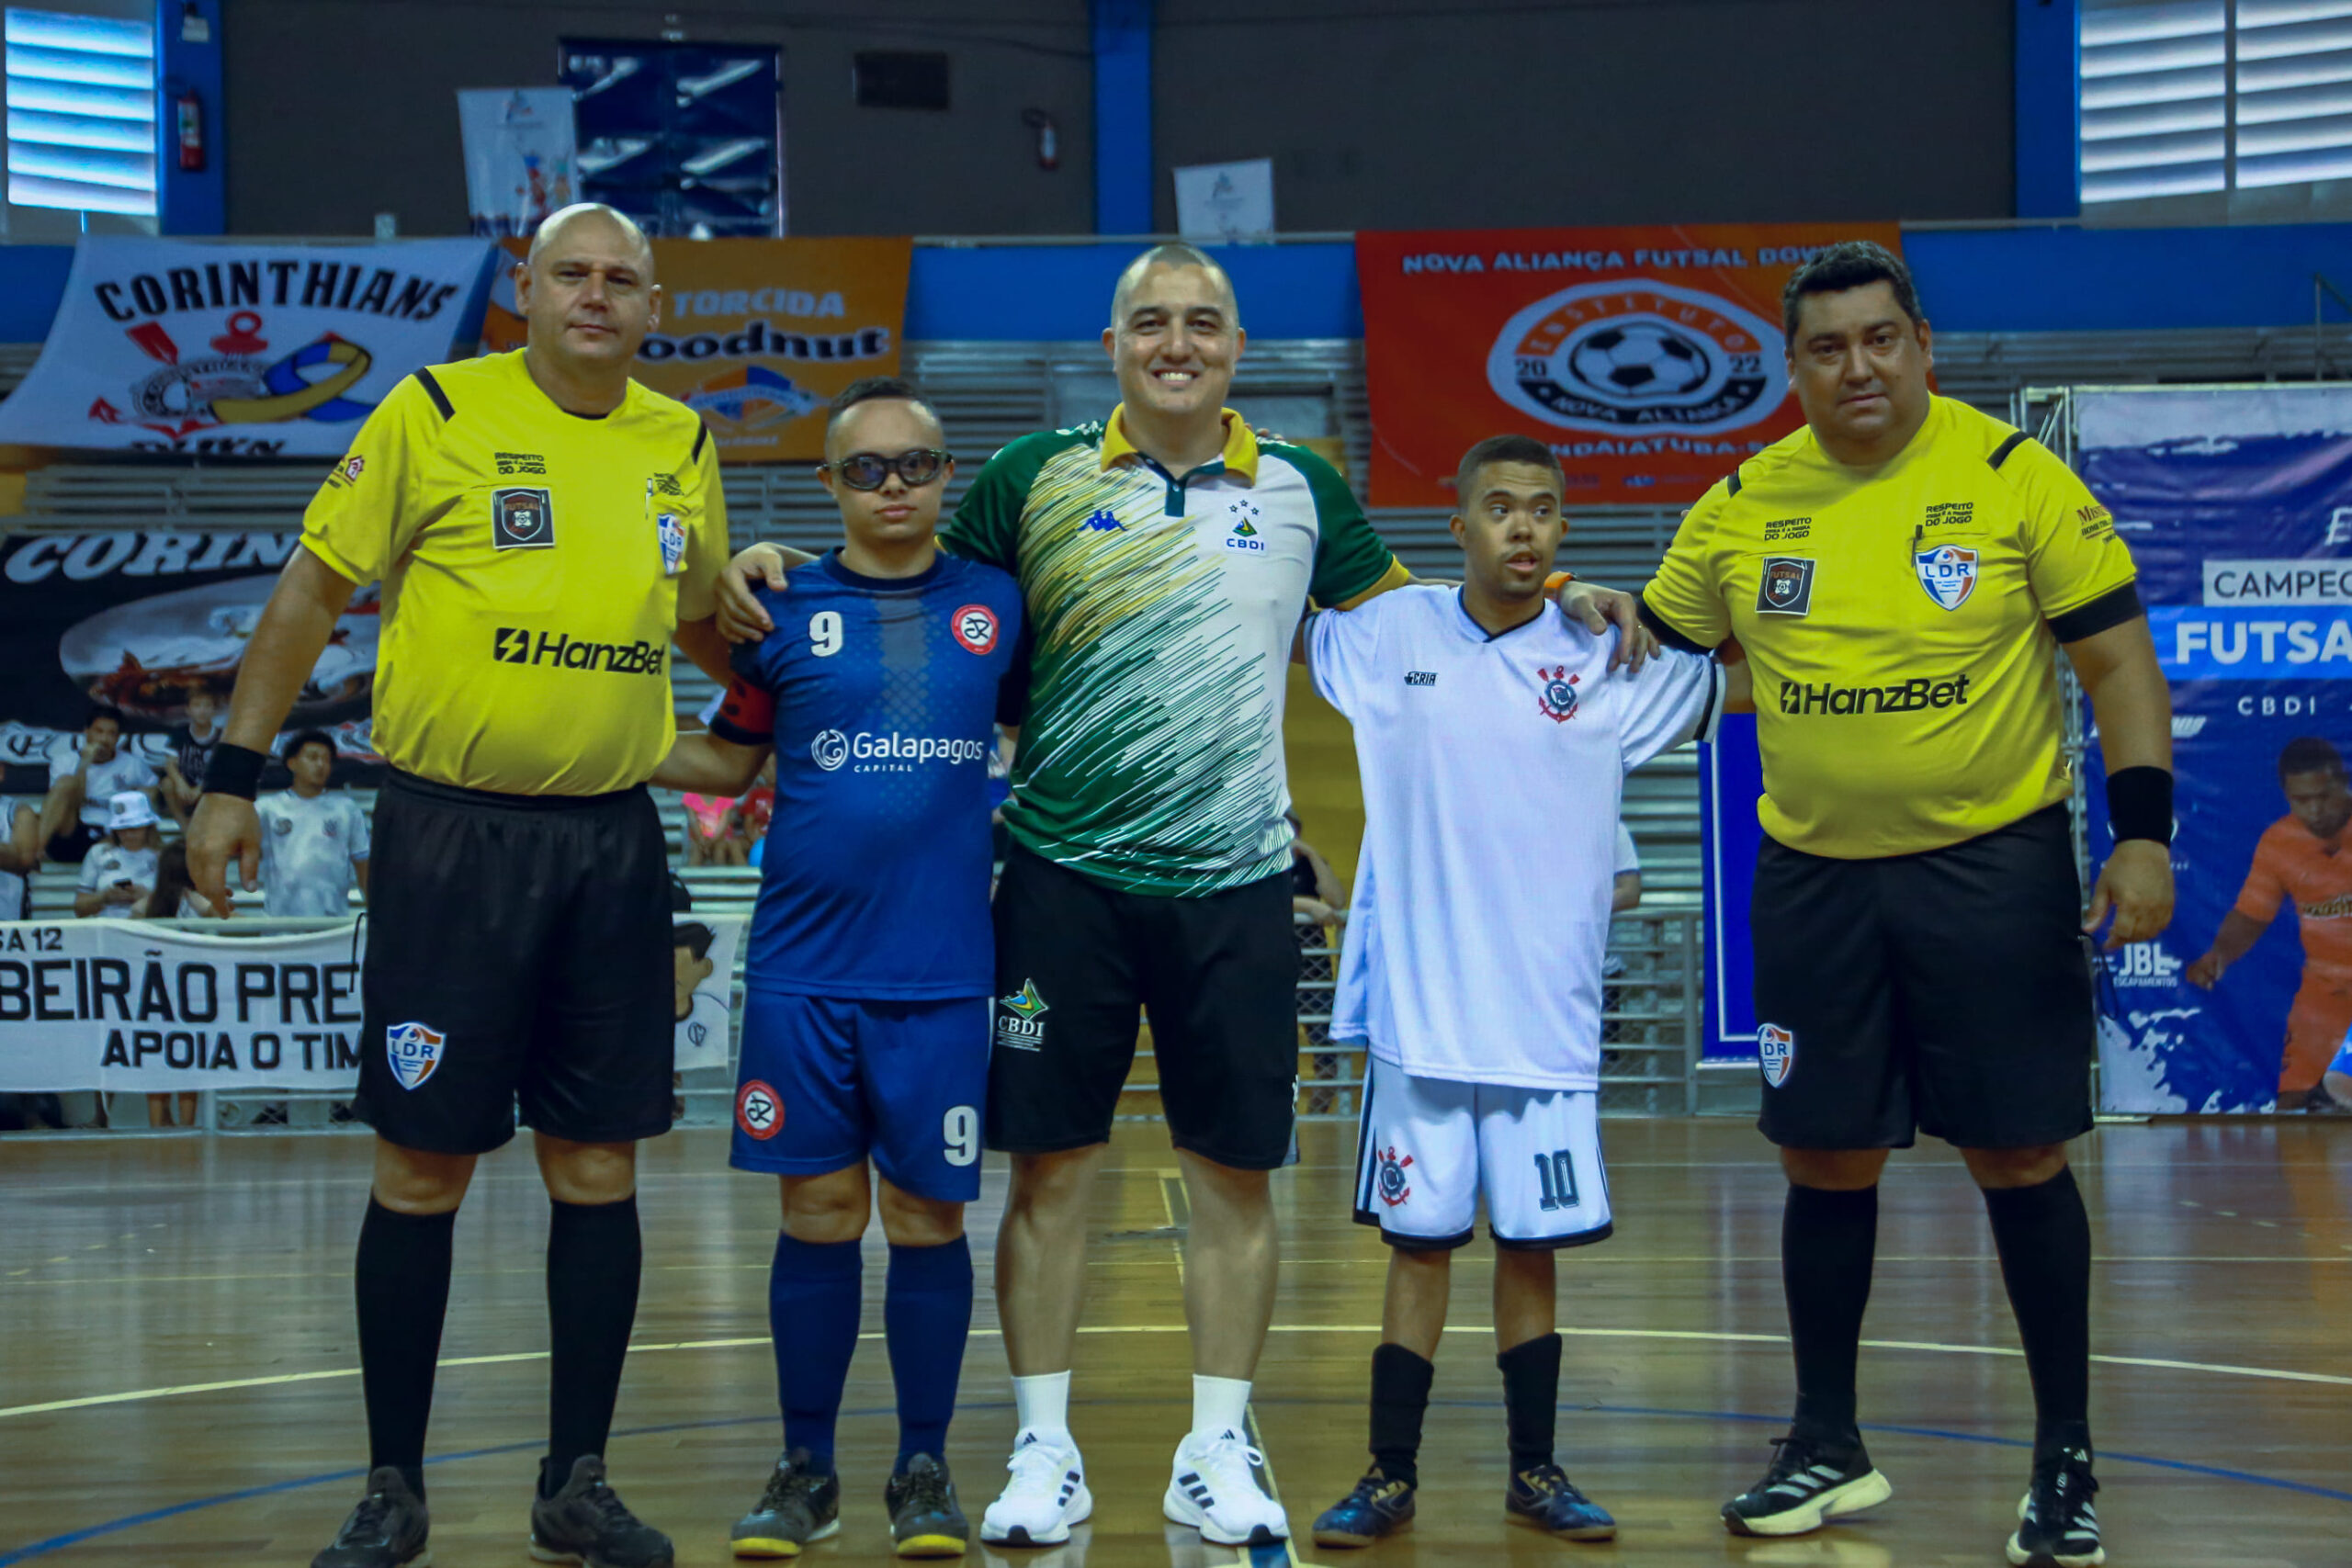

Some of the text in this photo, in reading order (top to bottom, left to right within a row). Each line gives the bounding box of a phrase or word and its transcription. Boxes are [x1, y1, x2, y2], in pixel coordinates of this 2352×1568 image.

[1403, 254, 1484, 274] NOVA
[1494, 251, 1623, 272] ALIANÇA
[1634, 248, 1747, 269] FUTSAL
[93, 261, 458, 322] CORINTHIANS
[673, 288, 845, 317] TORCIDA
[1516, 359, 1547, 378] 20
[1729, 356, 1760, 373] 22
[1926, 502, 1973, 513] RESPEITO
[1766, 517, 1812, 529] RESPEITO
[1926, 515, 1973, 527] DO JOGO
[1226, 537, 1264, 551] CBDI
[1764, 530, 1810, 541] DO JOGO
[1925, 562, 1971, 579] LDR
[808, 611, 842, 658] 9
[2176, 619, 2352, 664] FUTSA
[531, 631, 665, 675] HanzBet
[1804, 674, 1970, 716] HanzBet
[2237, 695, 2315, 716] CBDI
[853, 731, 984, 764] Galapagos
[854, 763, 913, 773] CAPITAL
[0, 926, 62, 952] A 12
[2119, 942, 2171, 976] JBL
[0, 950, 362, 1024] BEIRÃO PRE
[998, 1016, 1045, 1037] CBDI
[100, 1029, 238, 1069] APOIA
[250, 1032, 281, 1070] O
[391, 1040, 435, 1059] LDR
[1763, 1043, 1788, 1056] DR
[943, 1105, 979, 1167] 9
[1534, 1148, 1579, 1212] 10
